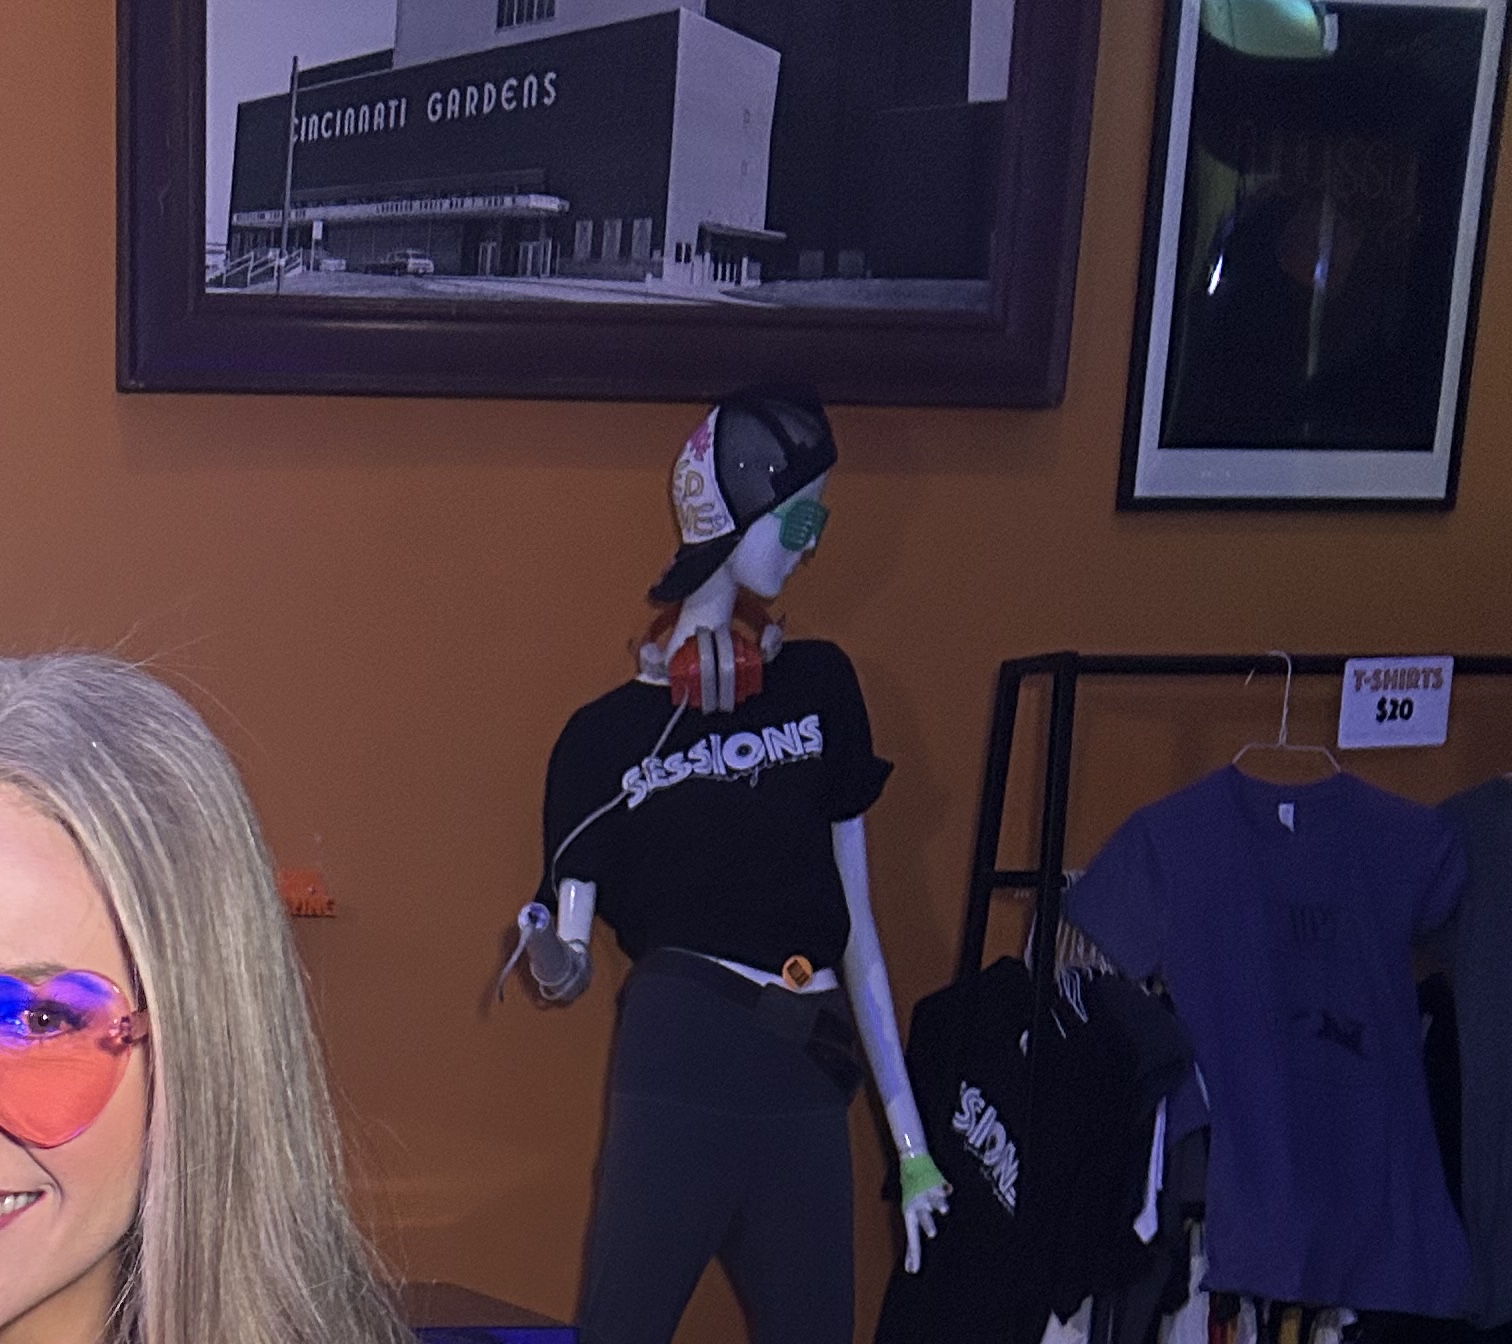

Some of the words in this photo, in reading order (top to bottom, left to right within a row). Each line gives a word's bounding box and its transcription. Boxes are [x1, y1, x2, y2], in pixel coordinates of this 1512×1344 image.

[427, 72, 557, 123] GARDENS
[1354, 667, 1444, 692] T-SHIRTS
[1376, 697, 1414, 723] $20
[621, 714, 823, 809] SESSIONS
